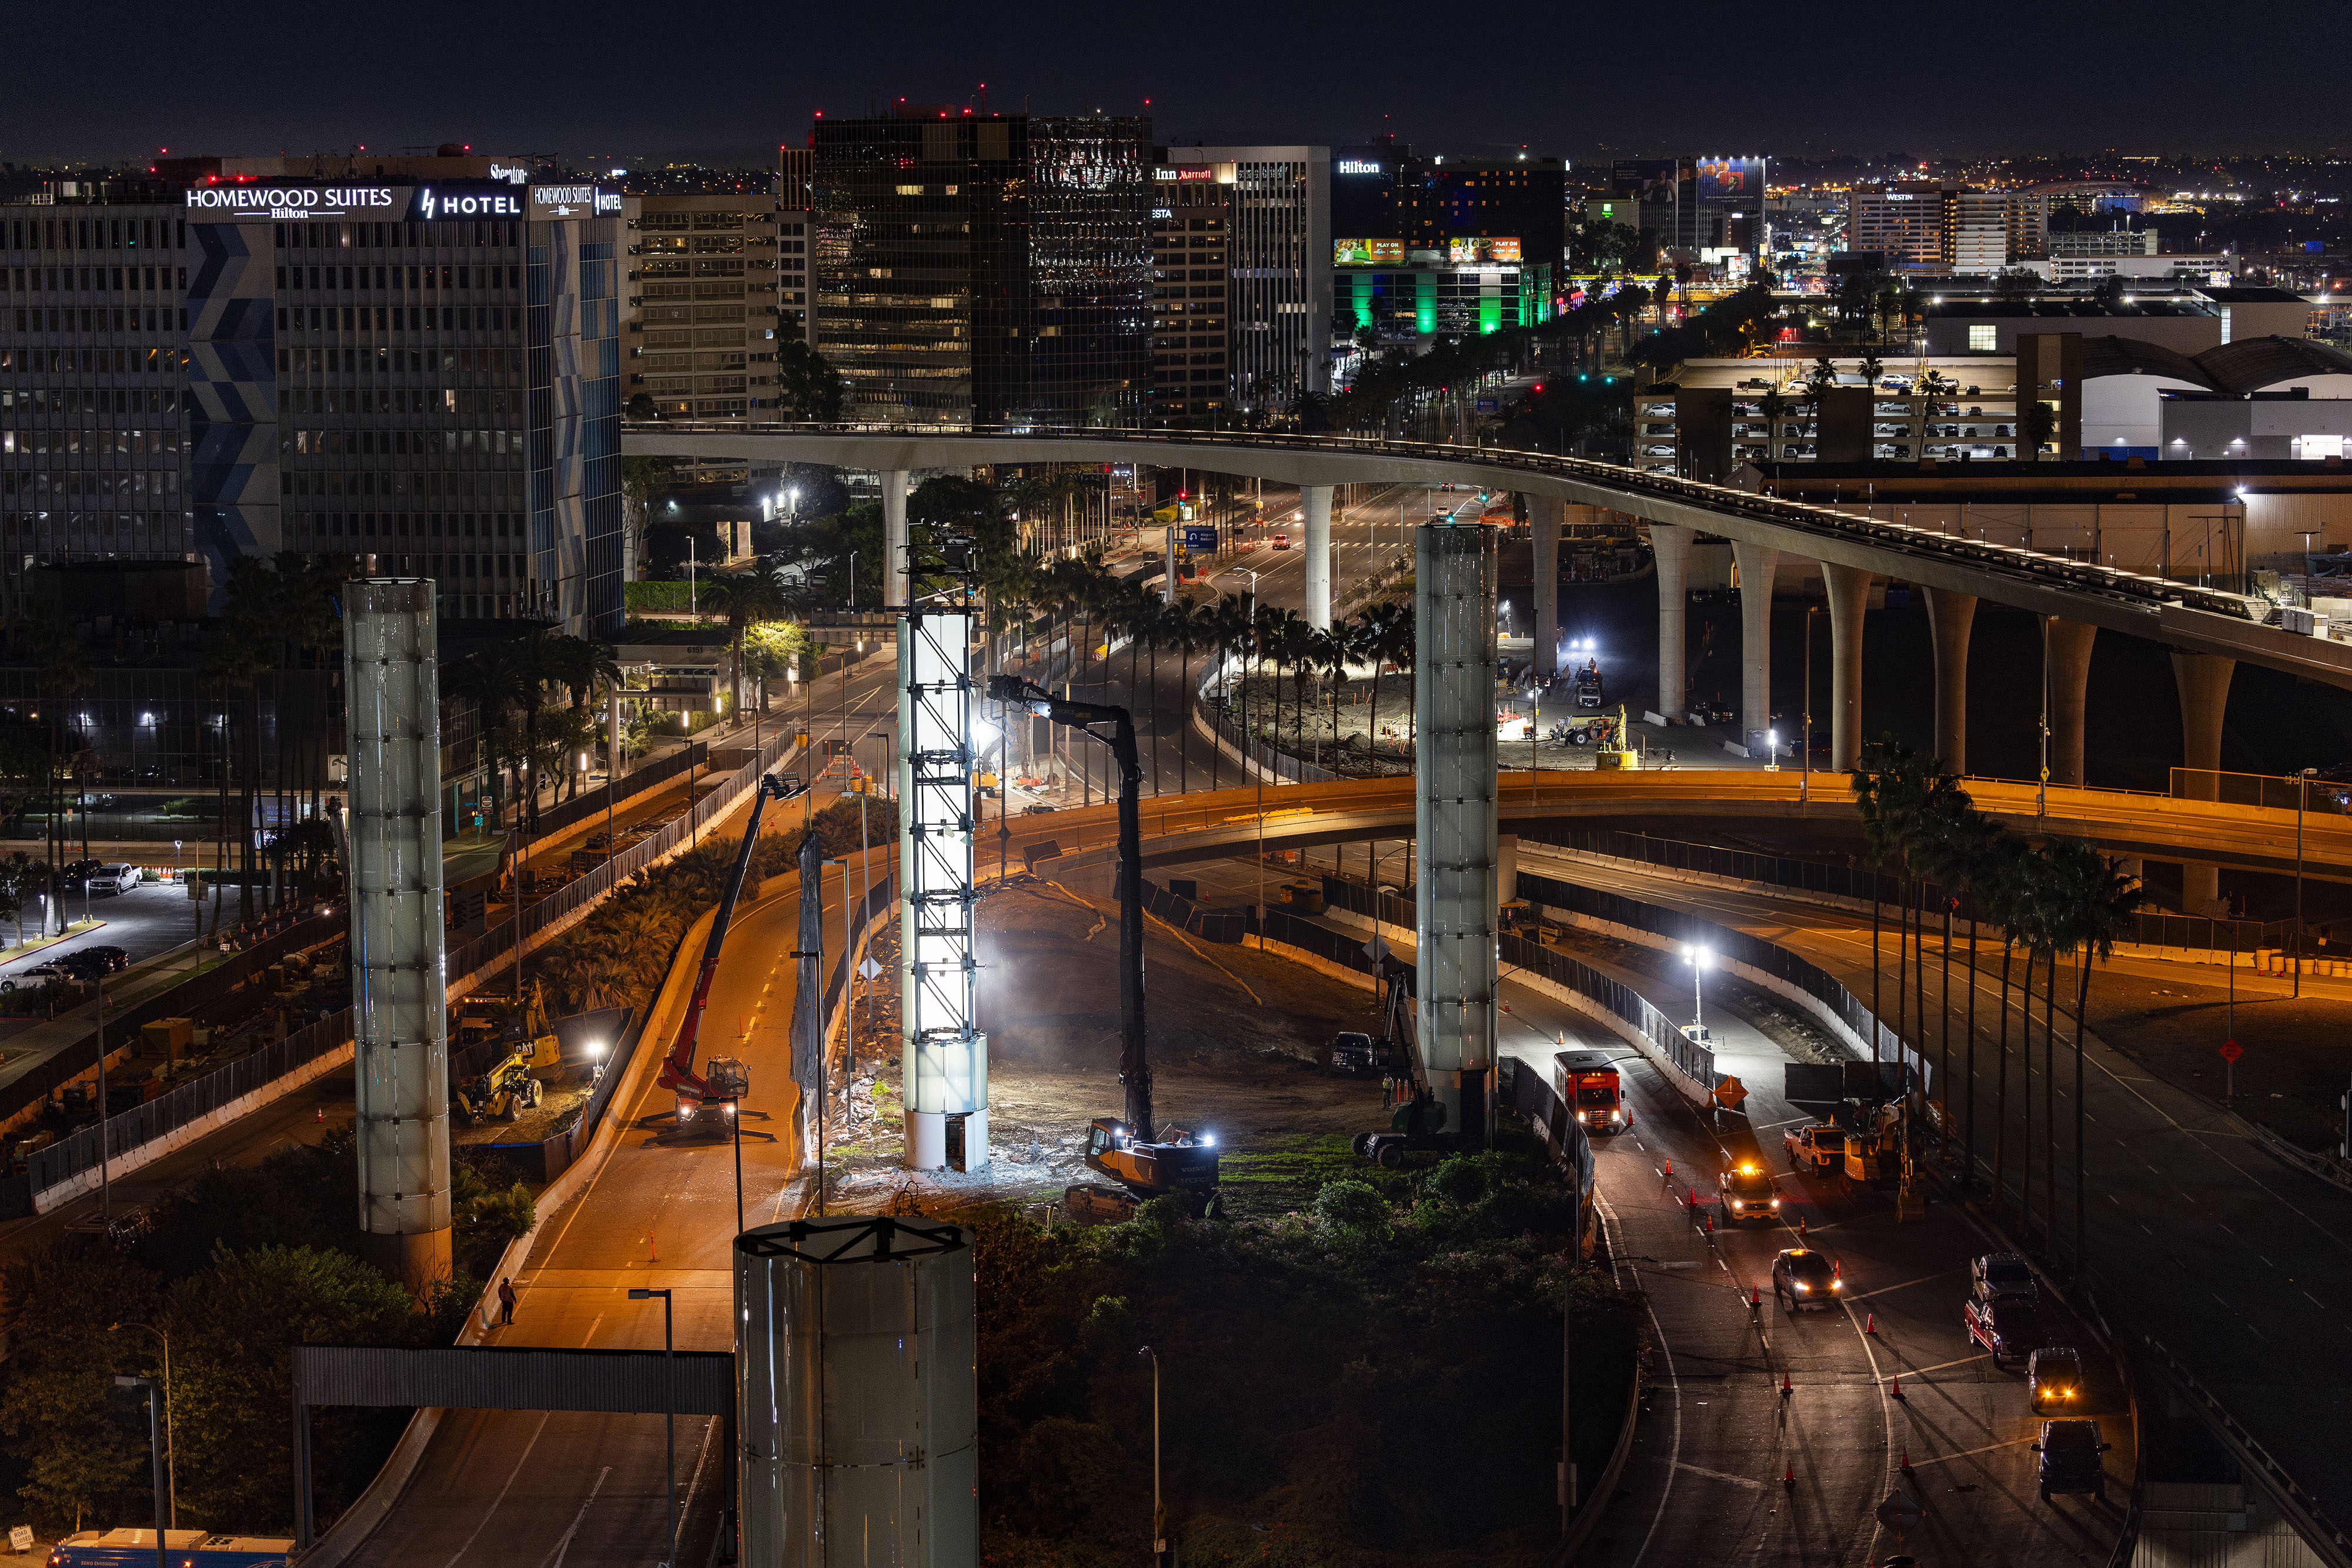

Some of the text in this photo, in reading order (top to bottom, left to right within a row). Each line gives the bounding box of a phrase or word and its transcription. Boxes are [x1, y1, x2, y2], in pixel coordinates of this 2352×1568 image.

[490, 163, 525, 184] Sheraton
[1339, 161, 1379, 173] Hilton
[1155, 168, 1211, 180] Inn Marriott
[187, 188, 392, 208] HOMEWOOD SUITES
[534, 186, 592, 205] HOMEWOOD SUITES
[600, 194, 622, 210] HOTEL
[444, 197, 520, 213] HOTEL
[558, 204, 570, 216] Hilton
[270, 207, 309, 219] Hilton
[515, 1042, 534, 1056] CAT
[14, 1529, 28, 1538] ROAD
[14, 1535, 32, 1546] CLOSED
